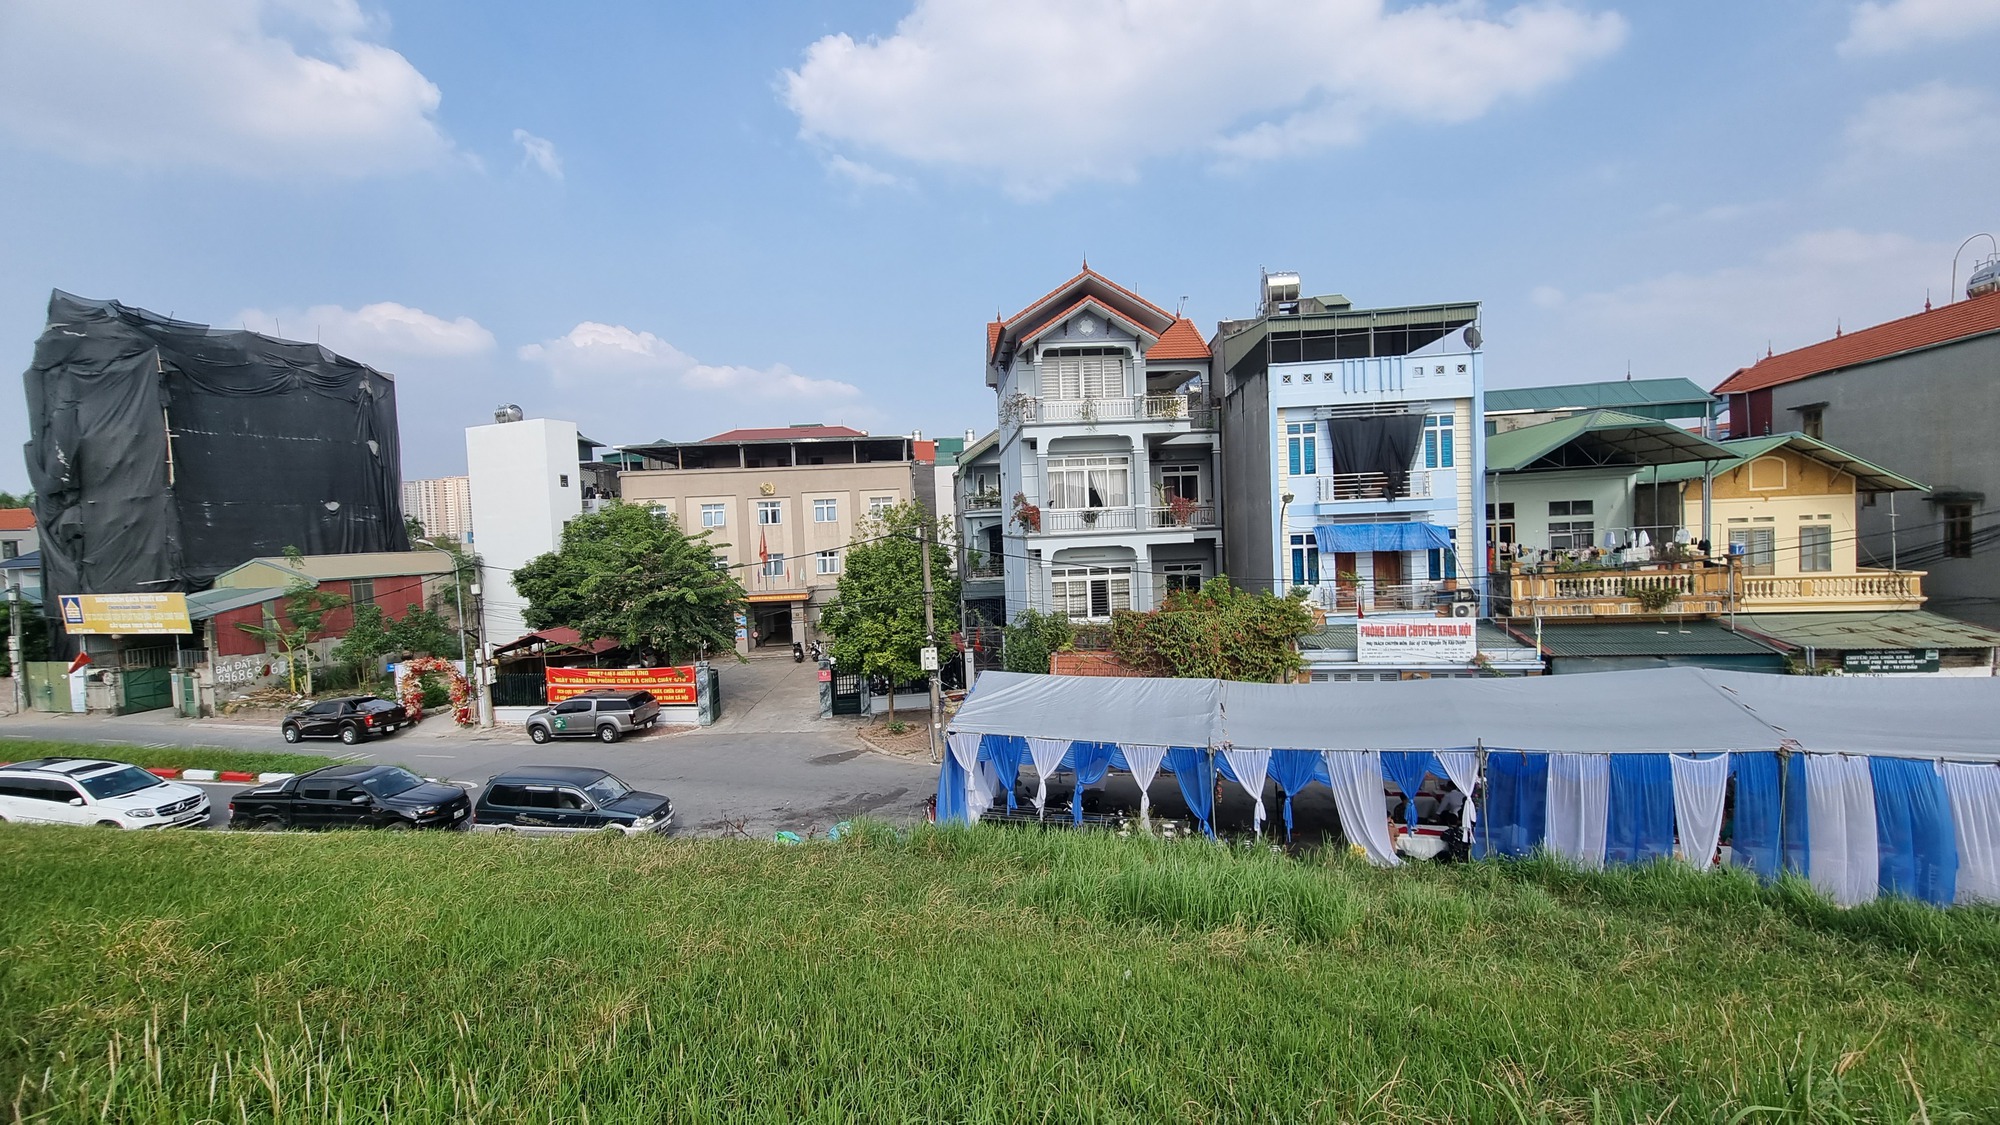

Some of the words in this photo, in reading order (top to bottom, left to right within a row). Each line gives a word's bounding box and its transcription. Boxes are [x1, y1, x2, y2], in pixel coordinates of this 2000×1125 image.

[1360, 623, 1385, 638] PHÒNG
[1386, 623, 1407, 637] KHÁM
[1408, 623, 1437, 637] CHUYÊN
[1438, 624, 1457, 637] KHOA
[1458, 622, 1471, 639] NỘI
[215, 661, 233, 674] BÁN
[234, 657, 252, 670] ĐẤT
